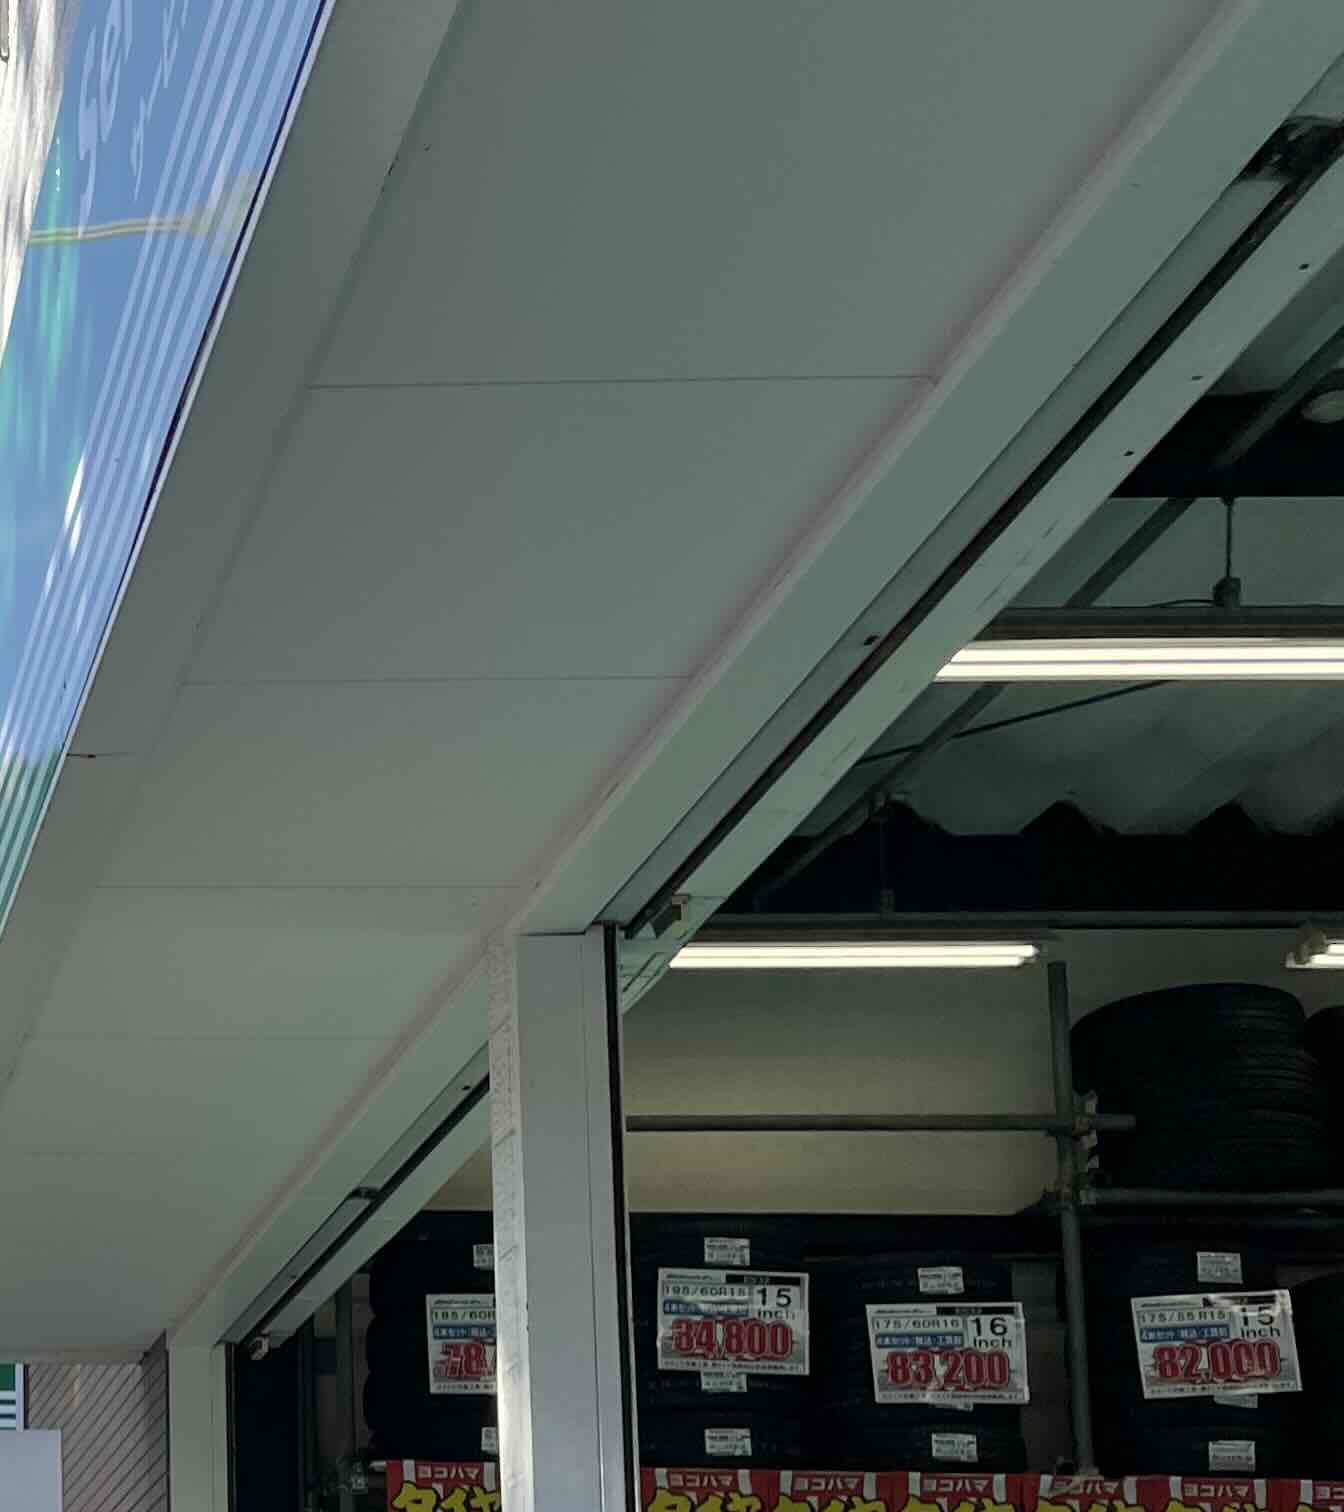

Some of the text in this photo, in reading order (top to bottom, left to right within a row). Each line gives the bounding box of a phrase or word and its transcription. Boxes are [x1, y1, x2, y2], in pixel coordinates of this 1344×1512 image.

[757, 1287, 792, 1309] 15
[969, 1316, 1008, 1336] 16
[1240, 1305, 1275, 1327] 15
[1240, 1326, 1280, 1339] inch
[973, 1336, 1012, 1350] inch
